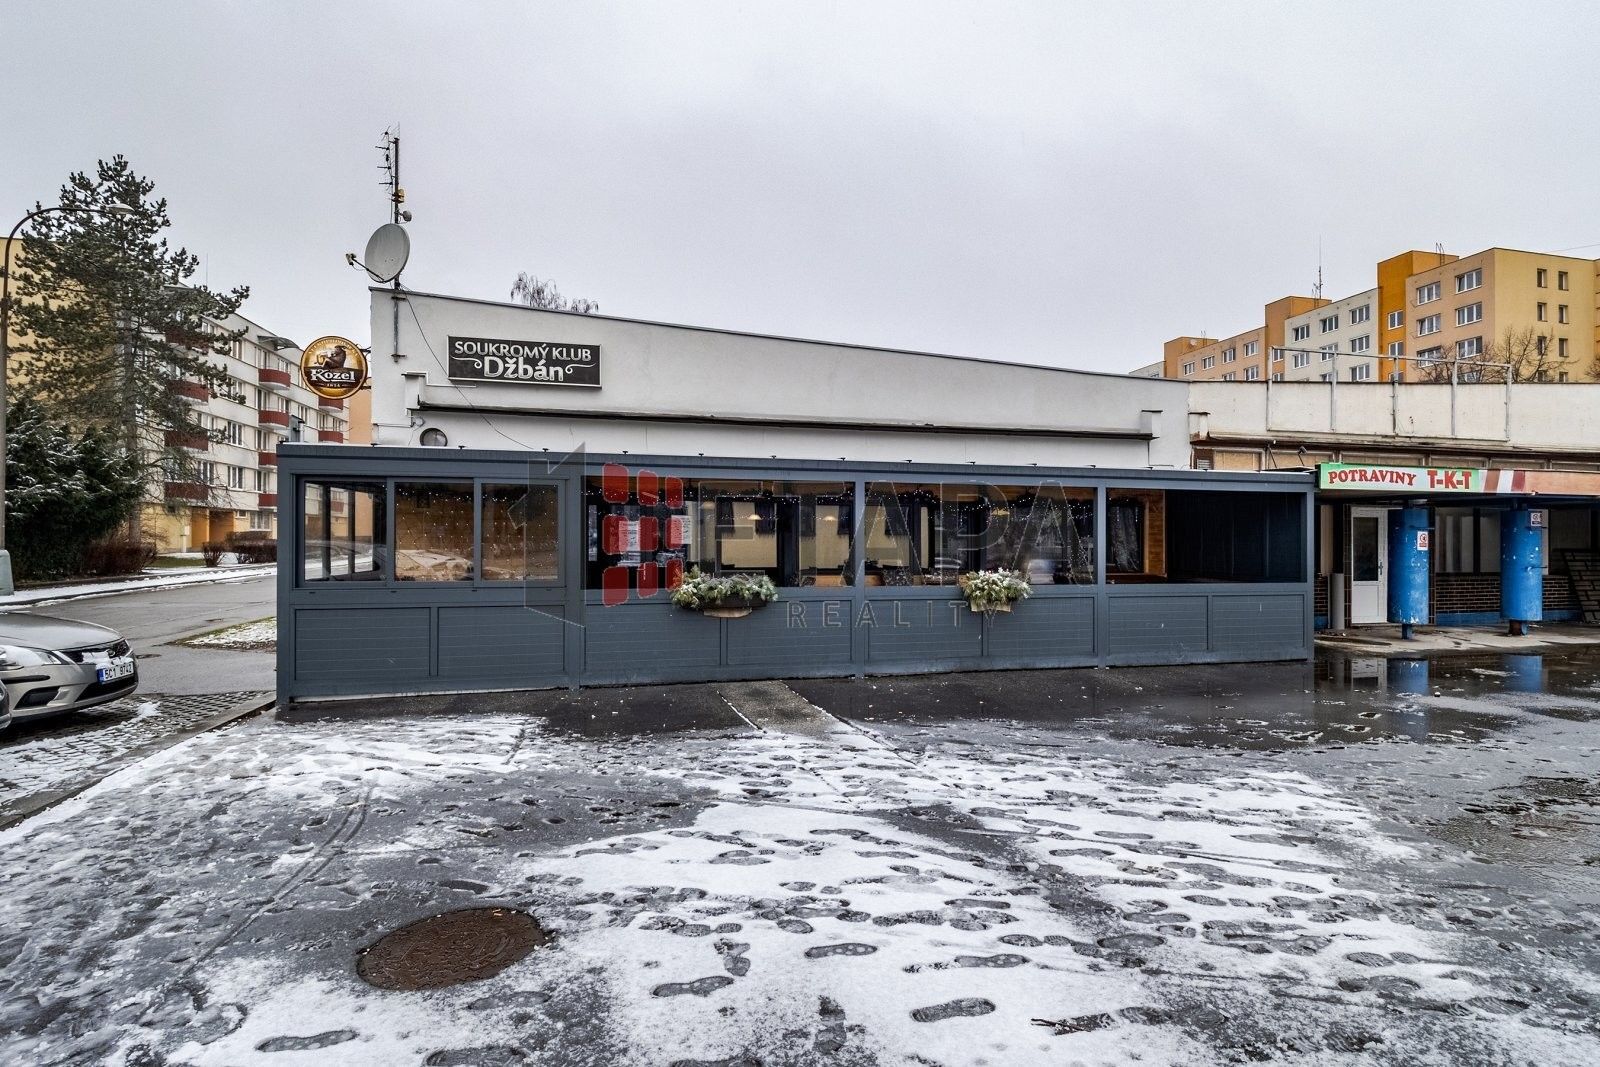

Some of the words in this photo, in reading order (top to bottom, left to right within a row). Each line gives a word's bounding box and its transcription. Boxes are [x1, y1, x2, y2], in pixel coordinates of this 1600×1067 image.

[454, 341, 549, 359] SOUKROMÝ
[552, 346, 592, 362] KLUB
[310, 369, 356, 382] Kozel
[483, 356, 564, 381] Džbán
[1328, 469, 1417, 486] POTRAVINY
[1427, 469, 1473, 490] T-K-T
